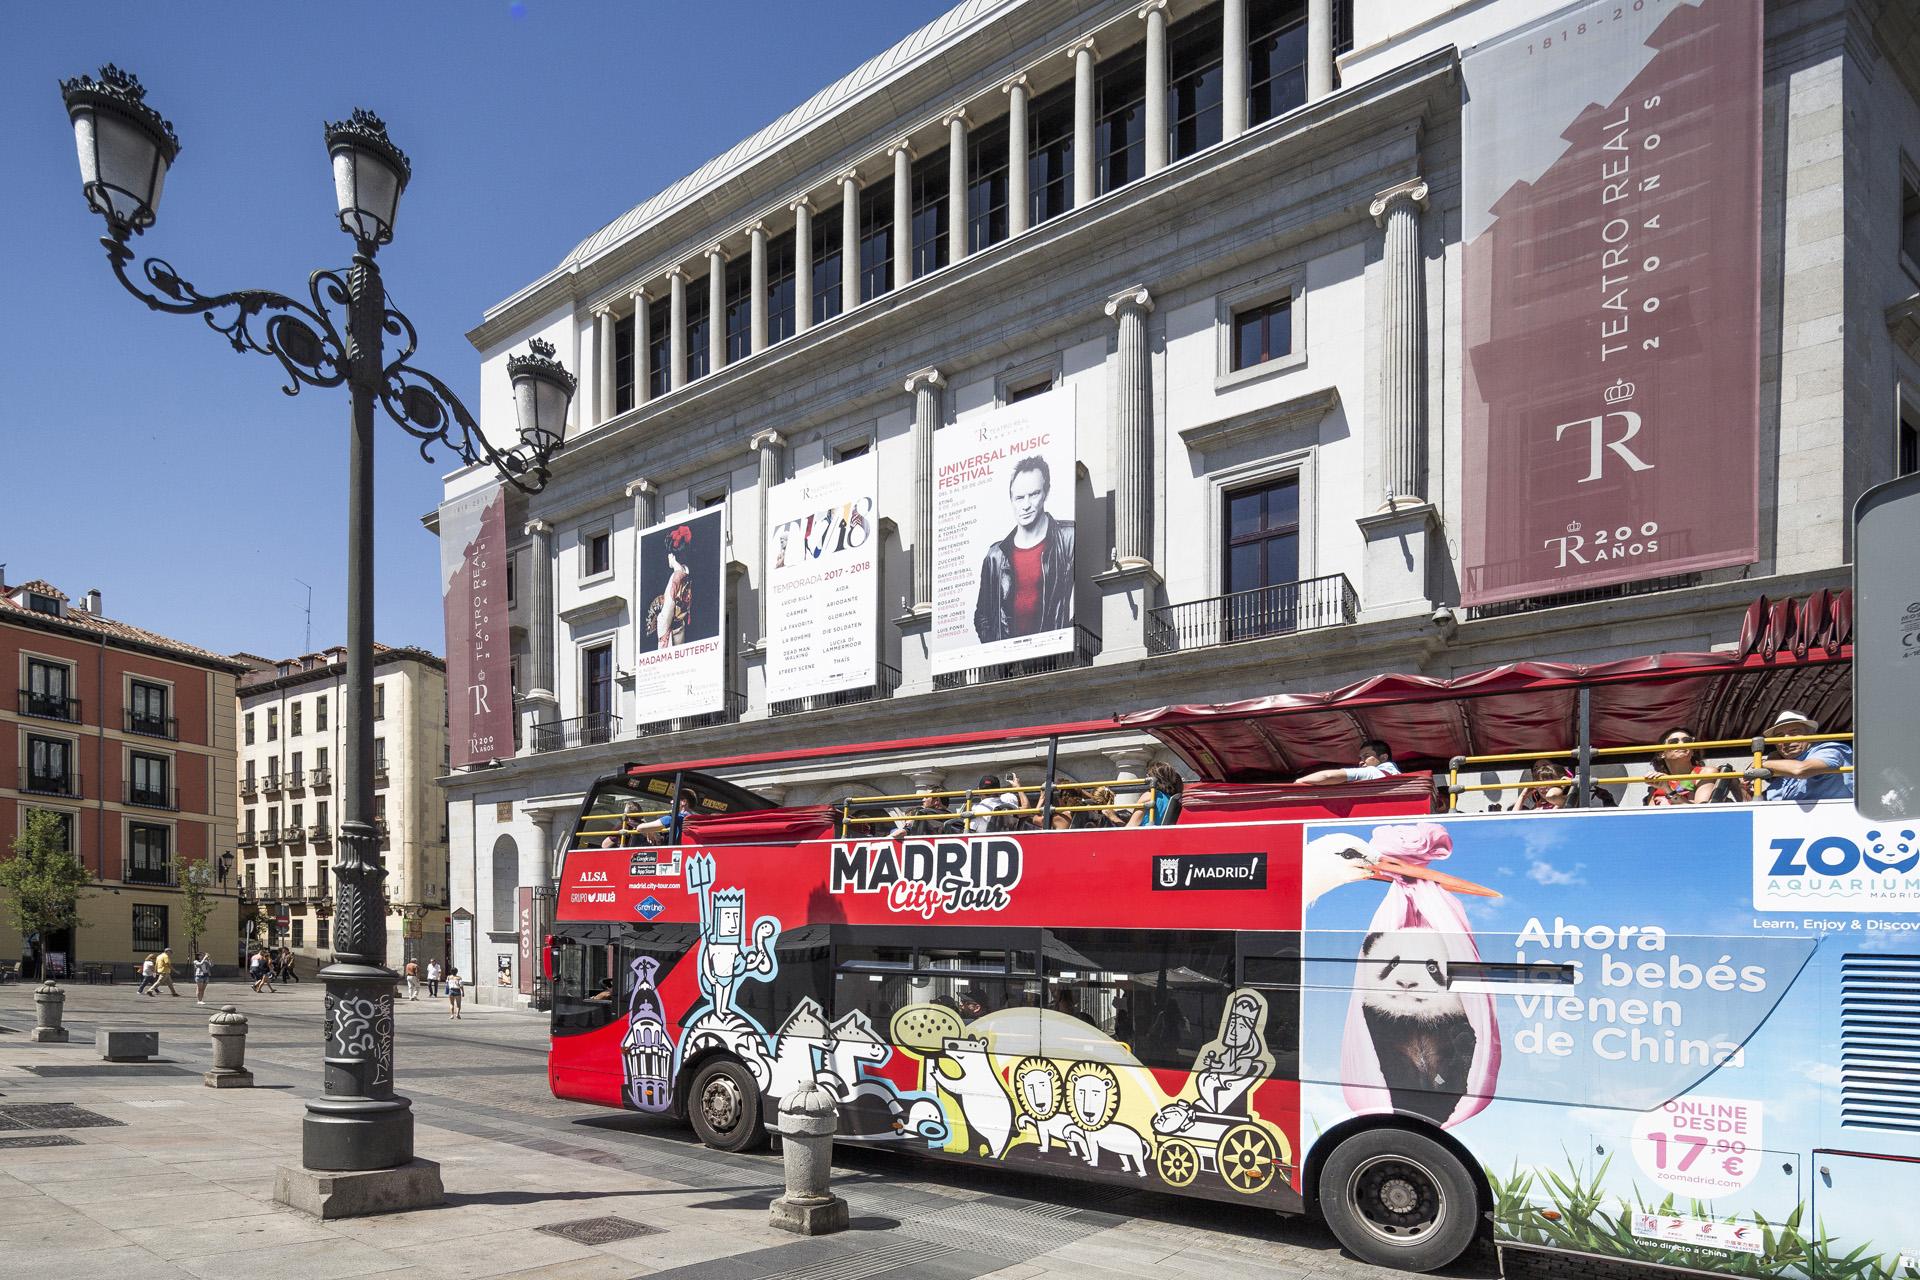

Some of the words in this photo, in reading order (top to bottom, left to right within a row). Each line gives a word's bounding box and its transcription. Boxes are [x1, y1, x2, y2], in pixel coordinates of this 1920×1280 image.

[1602, 107, 1629, 204] REAL
[1638, 95, 1661, 229] AÑOS
[1601, 219, 1629, 361] TEATRO
[1642, 255, 1660, 351] 200
[938, 448, 1006, 478] UNIVERSAL
[1010, 434, 1050, 455] MUSIC
[938, 464, 994, 490] FESTIVAL
[958, 518, 978, 528] CAMILO
[1594, 521, 1658, 545] 200
[938, 555, 965, 566] ZUCCHERO
[1594, 540, 1658, 562] AÑOS
[472, 546, 480, 590] REAL
[772, 574, 822, 594] TEMPORADA
[824, 568, 843, 580] 2017
[850, 561, 870, 574] 2018
[826, 596, 858, 608] ARIODANTE
[938, 597, 960, 606] ROSARIO
[786, 608, 808, 618] CARMEN
[474, 596, 483, 661] TEATRO
[788, 620, 814, 630] FAVORITA
[833, 622, 862, 633] SOLDATEN
[639, 652, 672, 666] MADAMA
[674, 642, 720, 659] BUTTERFLY
[798, 664, 815, 672] SCENE
[479, 736, 494, 744] 200
[480, 744, 494, 752] AÑOS
[831, 838, 1021, 892] MADRID
[1184, 857, 1258, 886] ¡MADRID!
[580, 872, 608, 882] ALSA
[628, 882, 681, 891] madrid.city-tour.com
[1768, 878, 1920, 890] AQUARIUM
[570, 892, 588, 902] GRUPO
[890, 880, 941, 917] City
[942, 877, 1008, 911] Tour
[522, 908, 530, 958] COSTA
[1515, 916, 1666, 951] Ahora
[1753, 919, 1799, 930] Learn,
[1803, 920, 1846, 932] Enjoy
[1850, 920, 1862, 930] &
[1602, 954, 1768, 992] bebés
[1514, 993, 1682, 1026] vienen
[1514, 1022, 1574, 1056] de
[1592, 1028, 1744, 1069] China
[1664, 1101, 1747, 1120] ONLINE
[1674, 1116, 1747, 1134] DESDE
[1657, 1172, 1741, 1188] zoomadrid.com
[1633, 1238, 1658, 1248] Vuelo
[1660, 1242, 1691, 1253] directo
[1702, 1248, 1728, 1258] China
